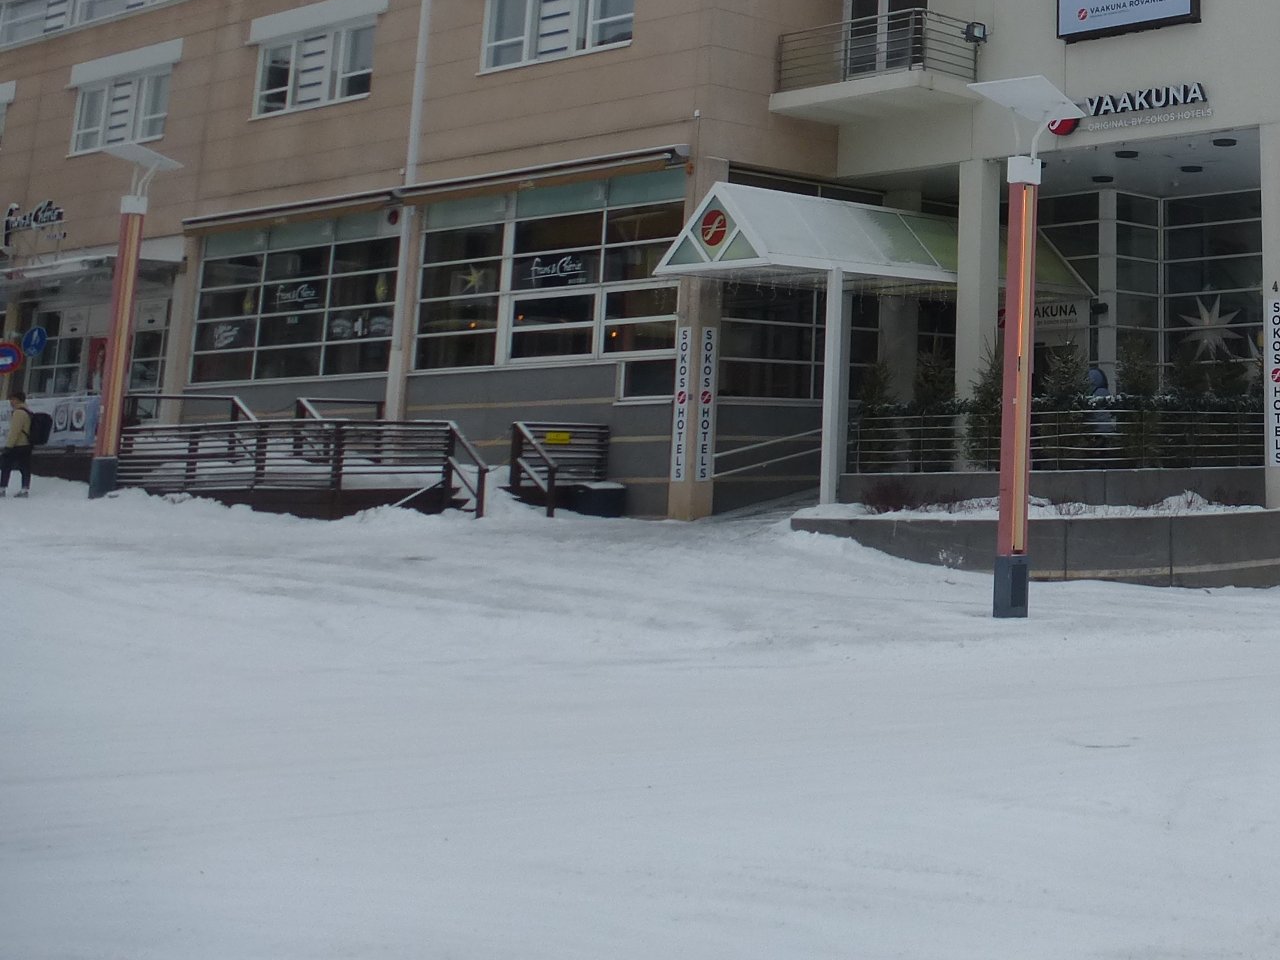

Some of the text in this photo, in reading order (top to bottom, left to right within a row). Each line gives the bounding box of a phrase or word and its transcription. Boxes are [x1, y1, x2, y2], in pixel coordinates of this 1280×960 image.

[1090, 1, 1127, 14] VAAKUNA
[1086, 82, 1208, 116] VAAKUNA
[1087, 108, 1213, 132] ORIGINAL BY SOKOS HOTELS
[1272, 280, 1279, 293] 4
[1034, 303, 1078, 319] AKUNA
[675, 329, 688, 479] SOKOS HOTELS
[699, 329, 714, 479] SOKOS HOTELS
